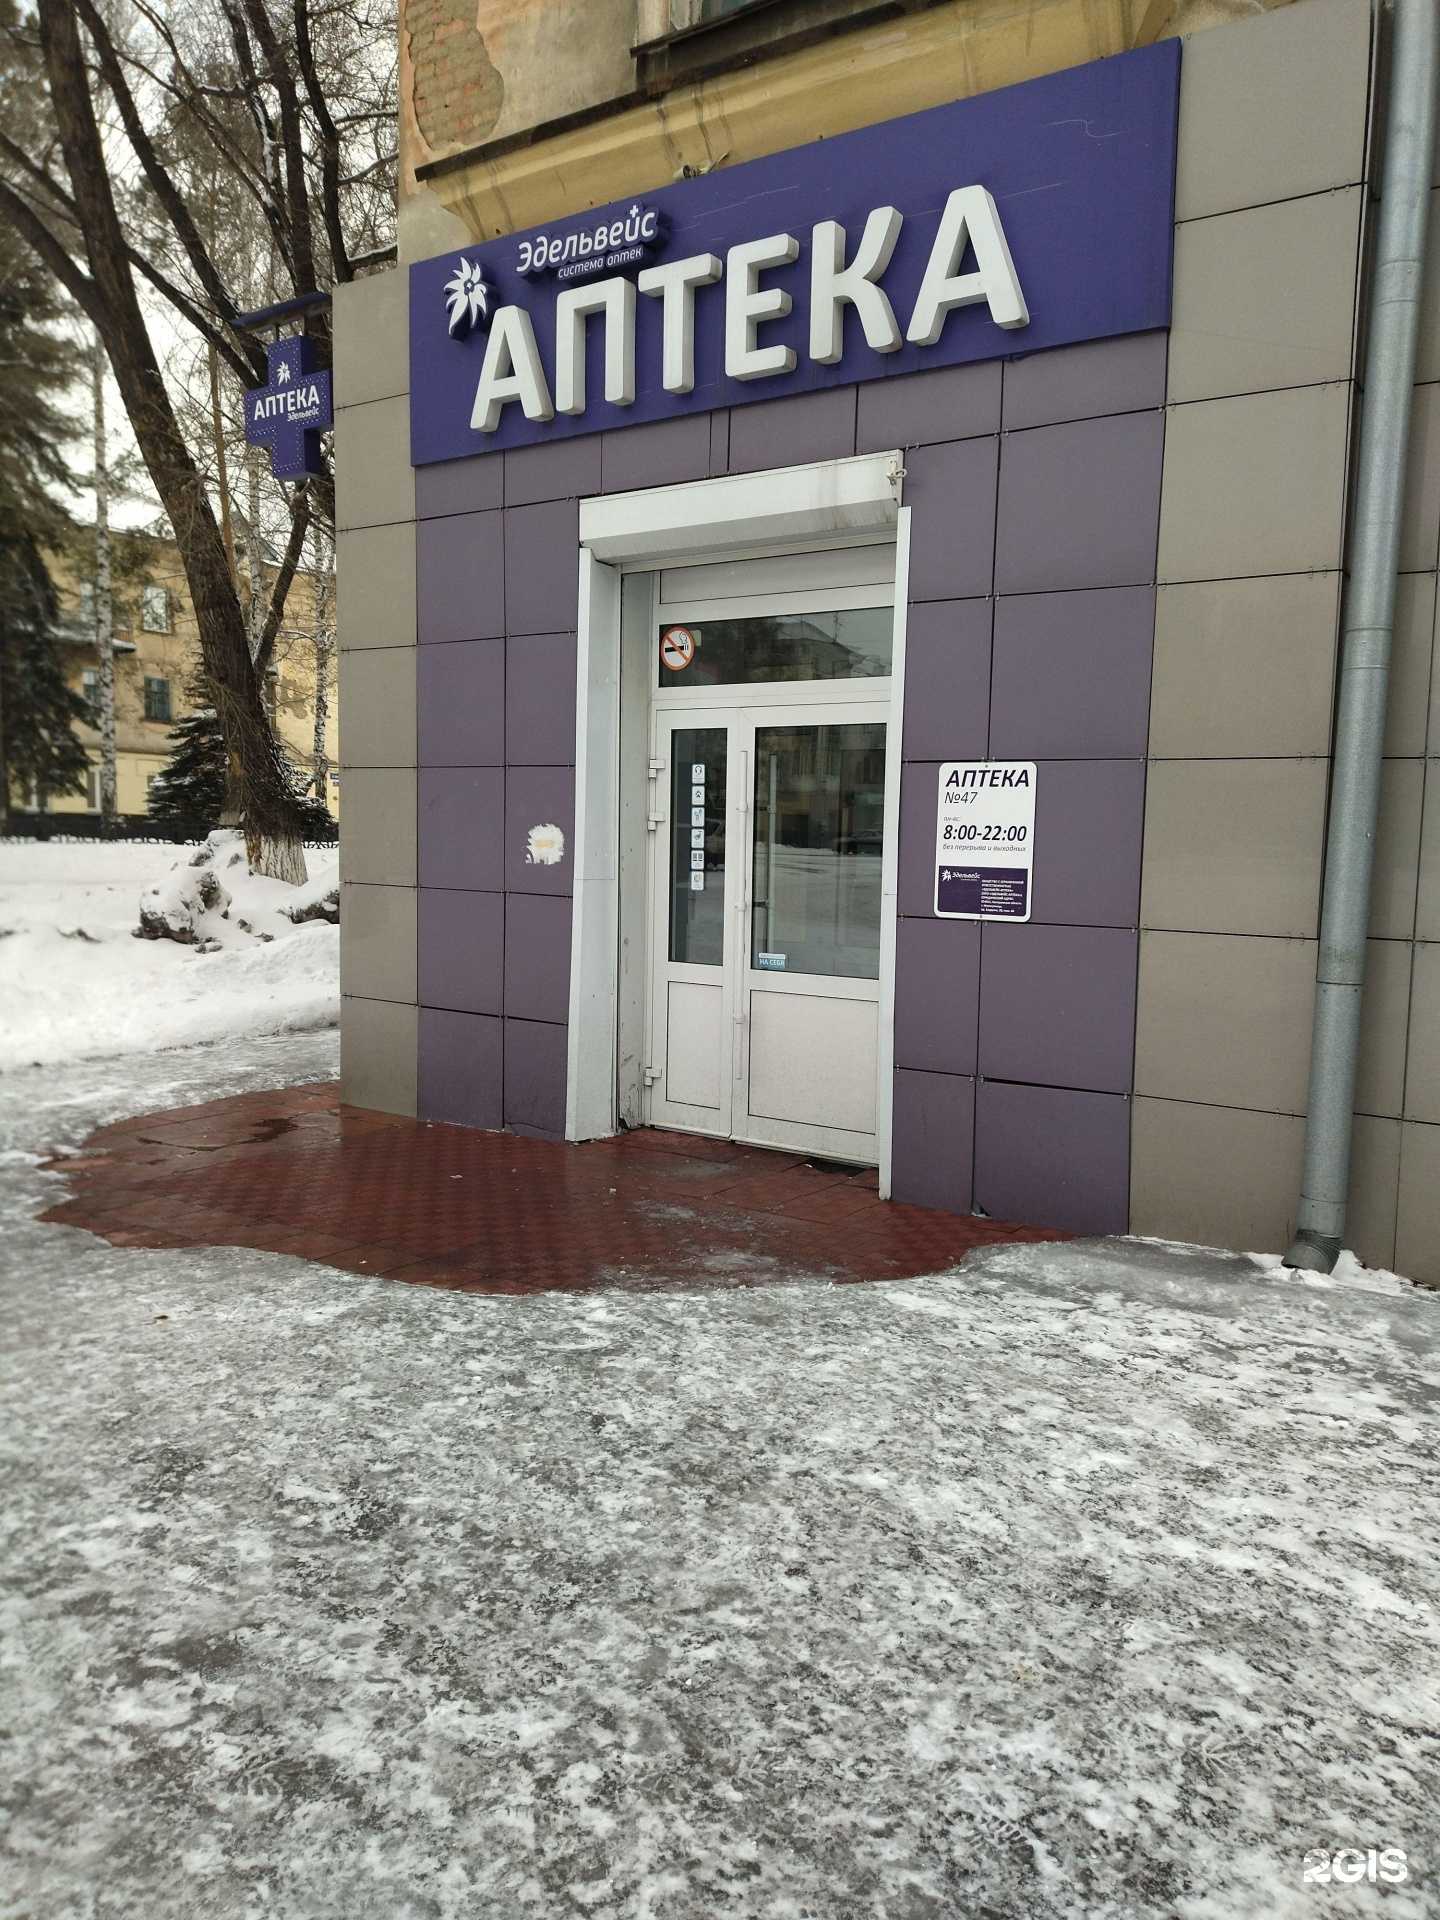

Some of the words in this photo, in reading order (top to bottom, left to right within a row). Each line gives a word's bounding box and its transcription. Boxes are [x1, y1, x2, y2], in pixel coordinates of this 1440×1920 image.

[516, 205, 656, 272] Эдельвейс
[558, 257, 604, 279] система
[607, 247, 644, 266] аптек
[470, 184, 1030, 433] АПТЕКА
[254, 385, 320, 421] АПТЕКА
[945, 769, 1030, 788] АПТЕКА
[944, 791, 978, 804] №47
[943, 824, 1027, 842] 8:00-22:00
